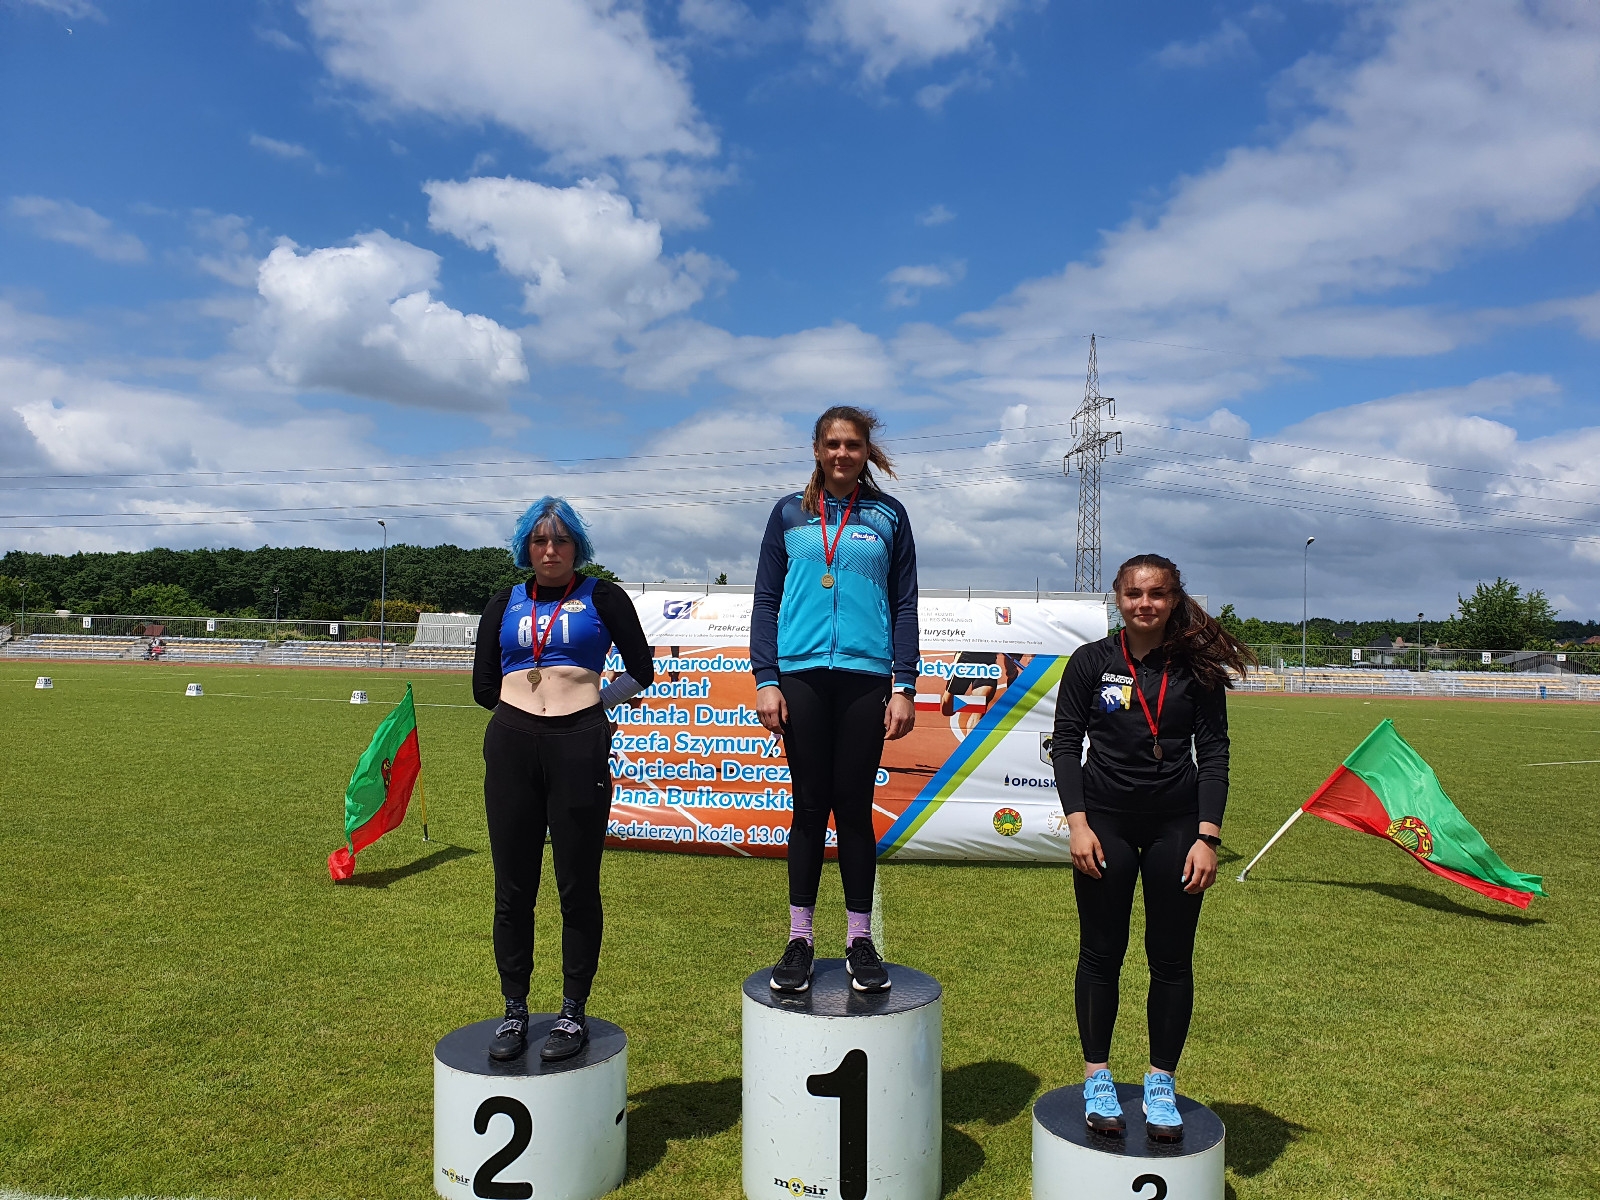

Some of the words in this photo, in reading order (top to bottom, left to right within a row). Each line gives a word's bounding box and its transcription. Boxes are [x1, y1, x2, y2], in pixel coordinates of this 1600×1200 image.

[924, 628, 966, 637] turystykę
[676, 733, 781, 755] Szymury,
[607, 821, 692, 842] Kędzierzyn
[698, 825, 742, 843] Koźle
[1404, 818, 1431, 851] LZS
[1149, 1086, 1172, 1097] NIKE
[806, 1048, 868, 1200] 1
[473, 1095, 534, 1199] 2
